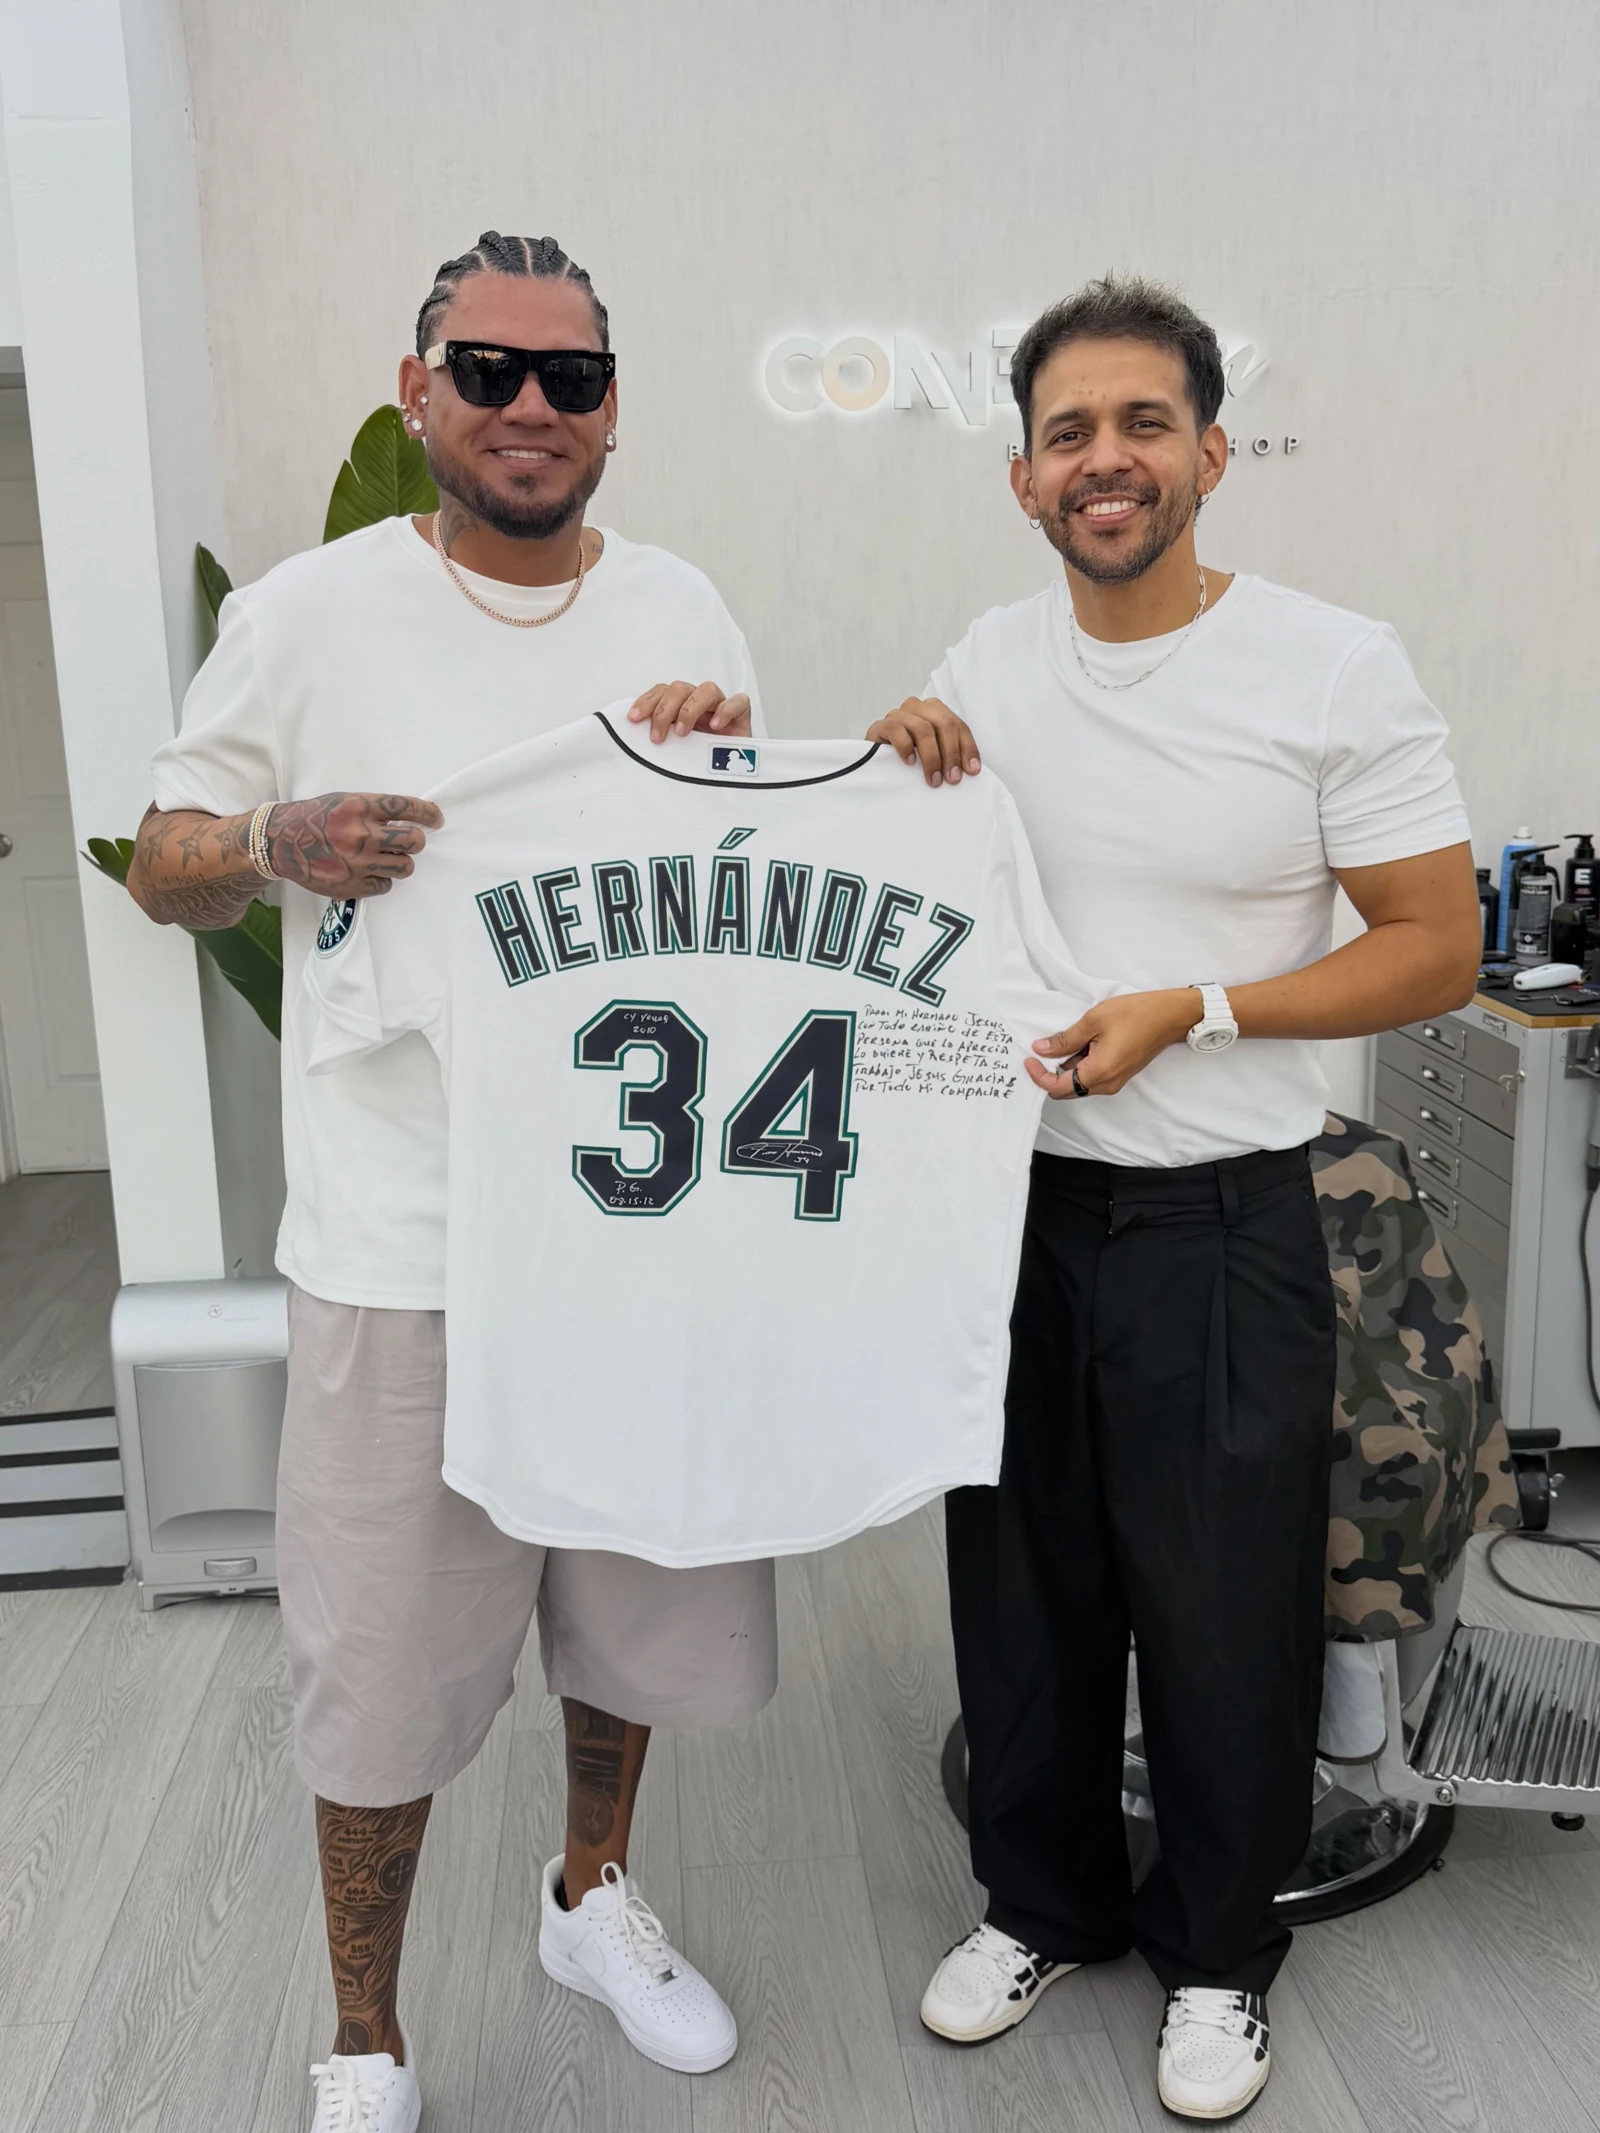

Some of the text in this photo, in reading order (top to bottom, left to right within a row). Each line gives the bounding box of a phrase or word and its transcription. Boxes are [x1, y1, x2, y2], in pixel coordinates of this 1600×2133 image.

[475, 827, 974, 1007] HERNÁNDEZ
[632, 1025, 657, 1034] 2010
[571, 998, 859, 1222] 34
[344, 1827, 367, 1837] 444
[346, 1887, 367, 1896] 666
[351, 1943, 370, 1954] 888
